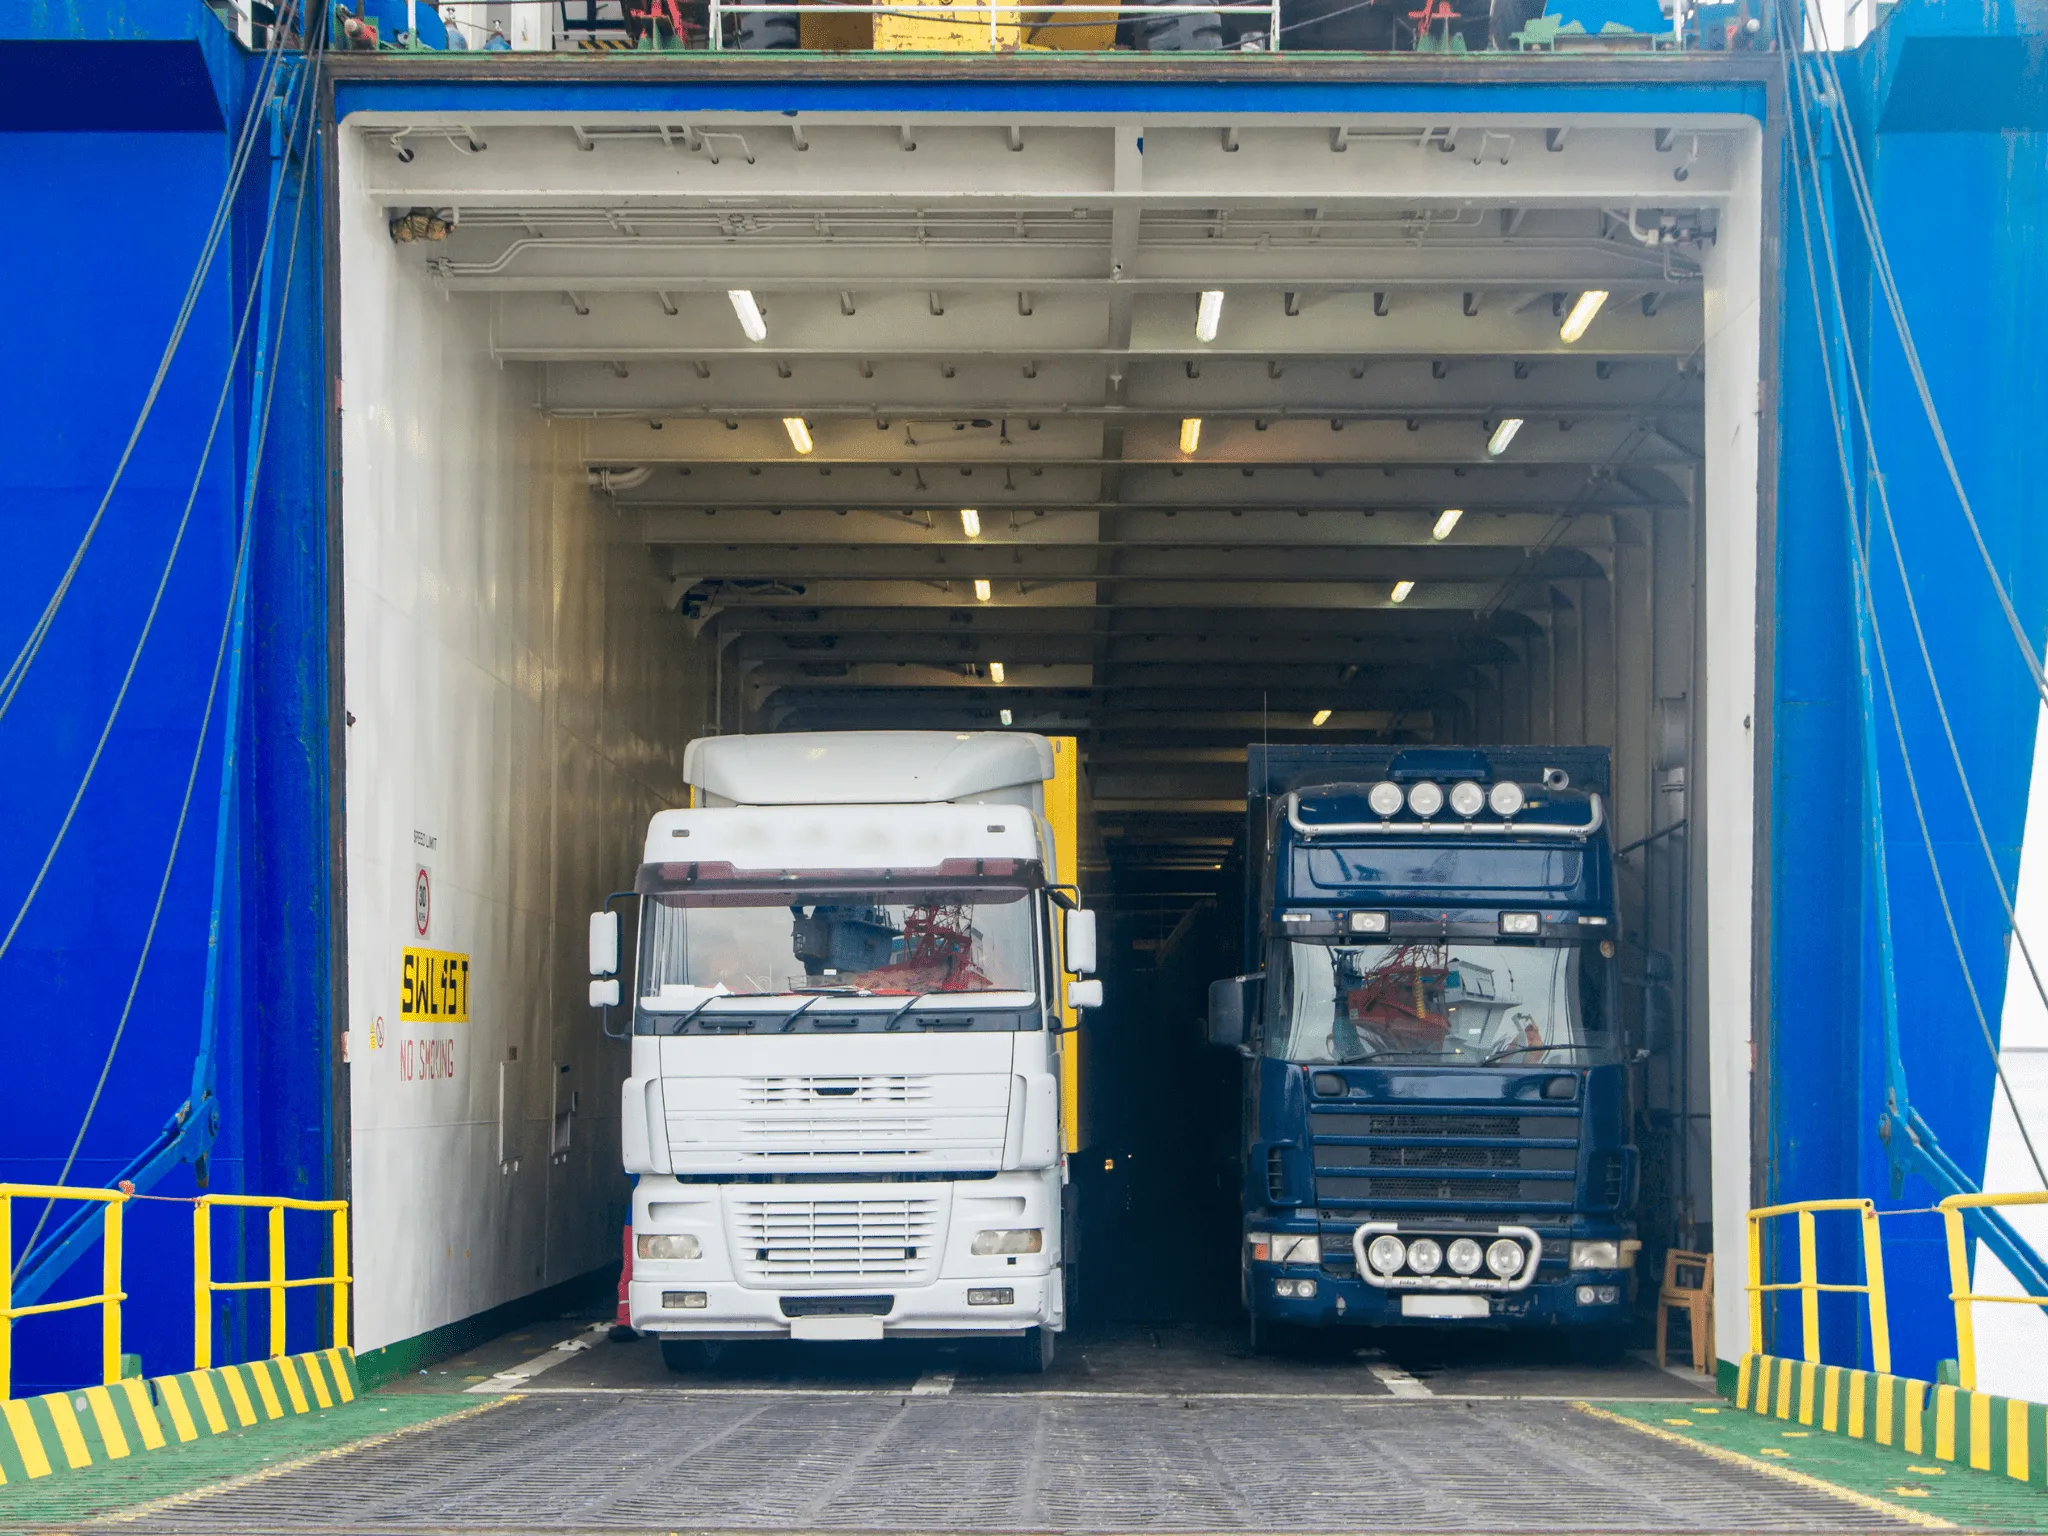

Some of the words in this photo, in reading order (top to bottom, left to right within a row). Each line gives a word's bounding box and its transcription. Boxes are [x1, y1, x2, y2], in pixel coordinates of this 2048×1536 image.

[413, 829, 426, 847] SPEED
[419, 884, 427, 907] 30
[402, 954, 437, 1014] SWL
[400, 1039, 413, 1081] NO
[419, 1039, 454, 1081] SMOKING
